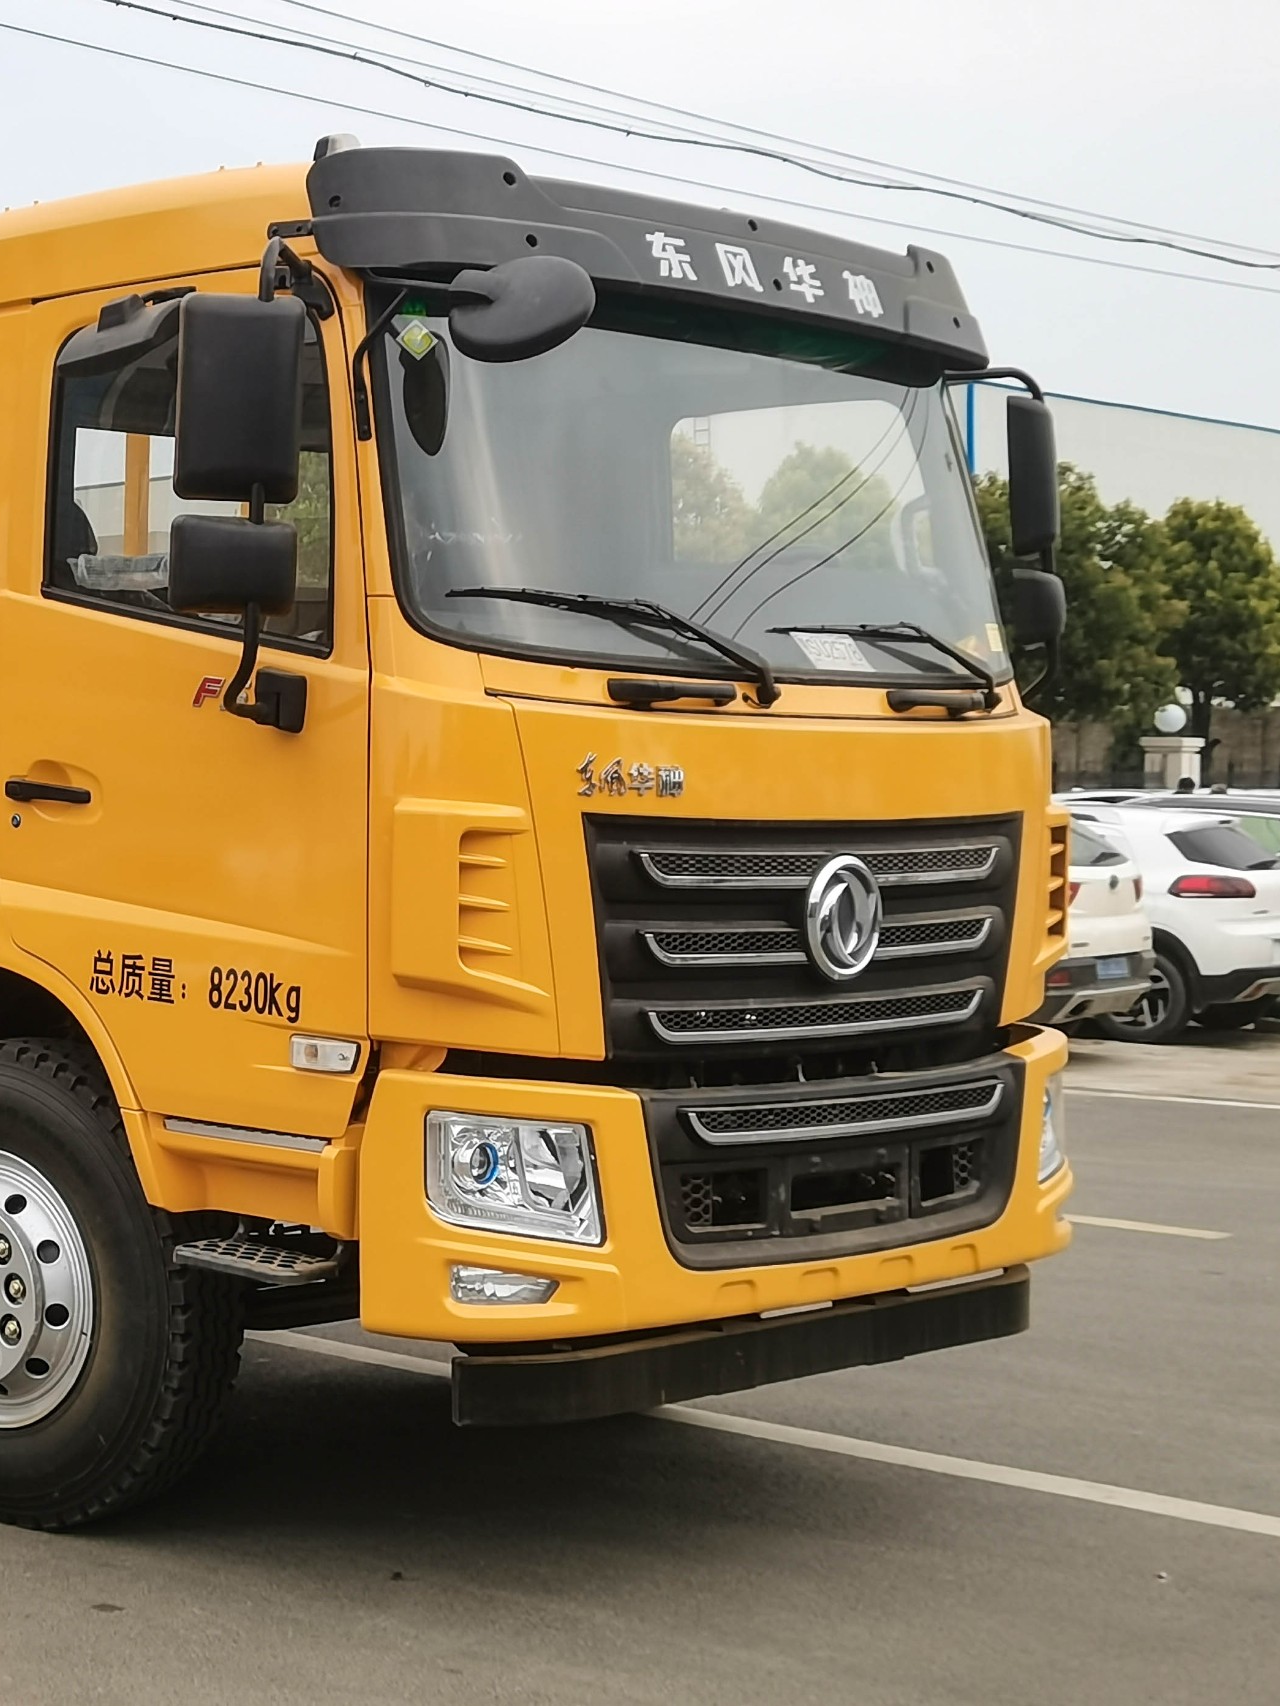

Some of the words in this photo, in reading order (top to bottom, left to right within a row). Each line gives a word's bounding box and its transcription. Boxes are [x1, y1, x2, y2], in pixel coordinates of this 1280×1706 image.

[645, 232, 884, 318] 东风华神
[208, 966, 301, 1024] 8230kg
